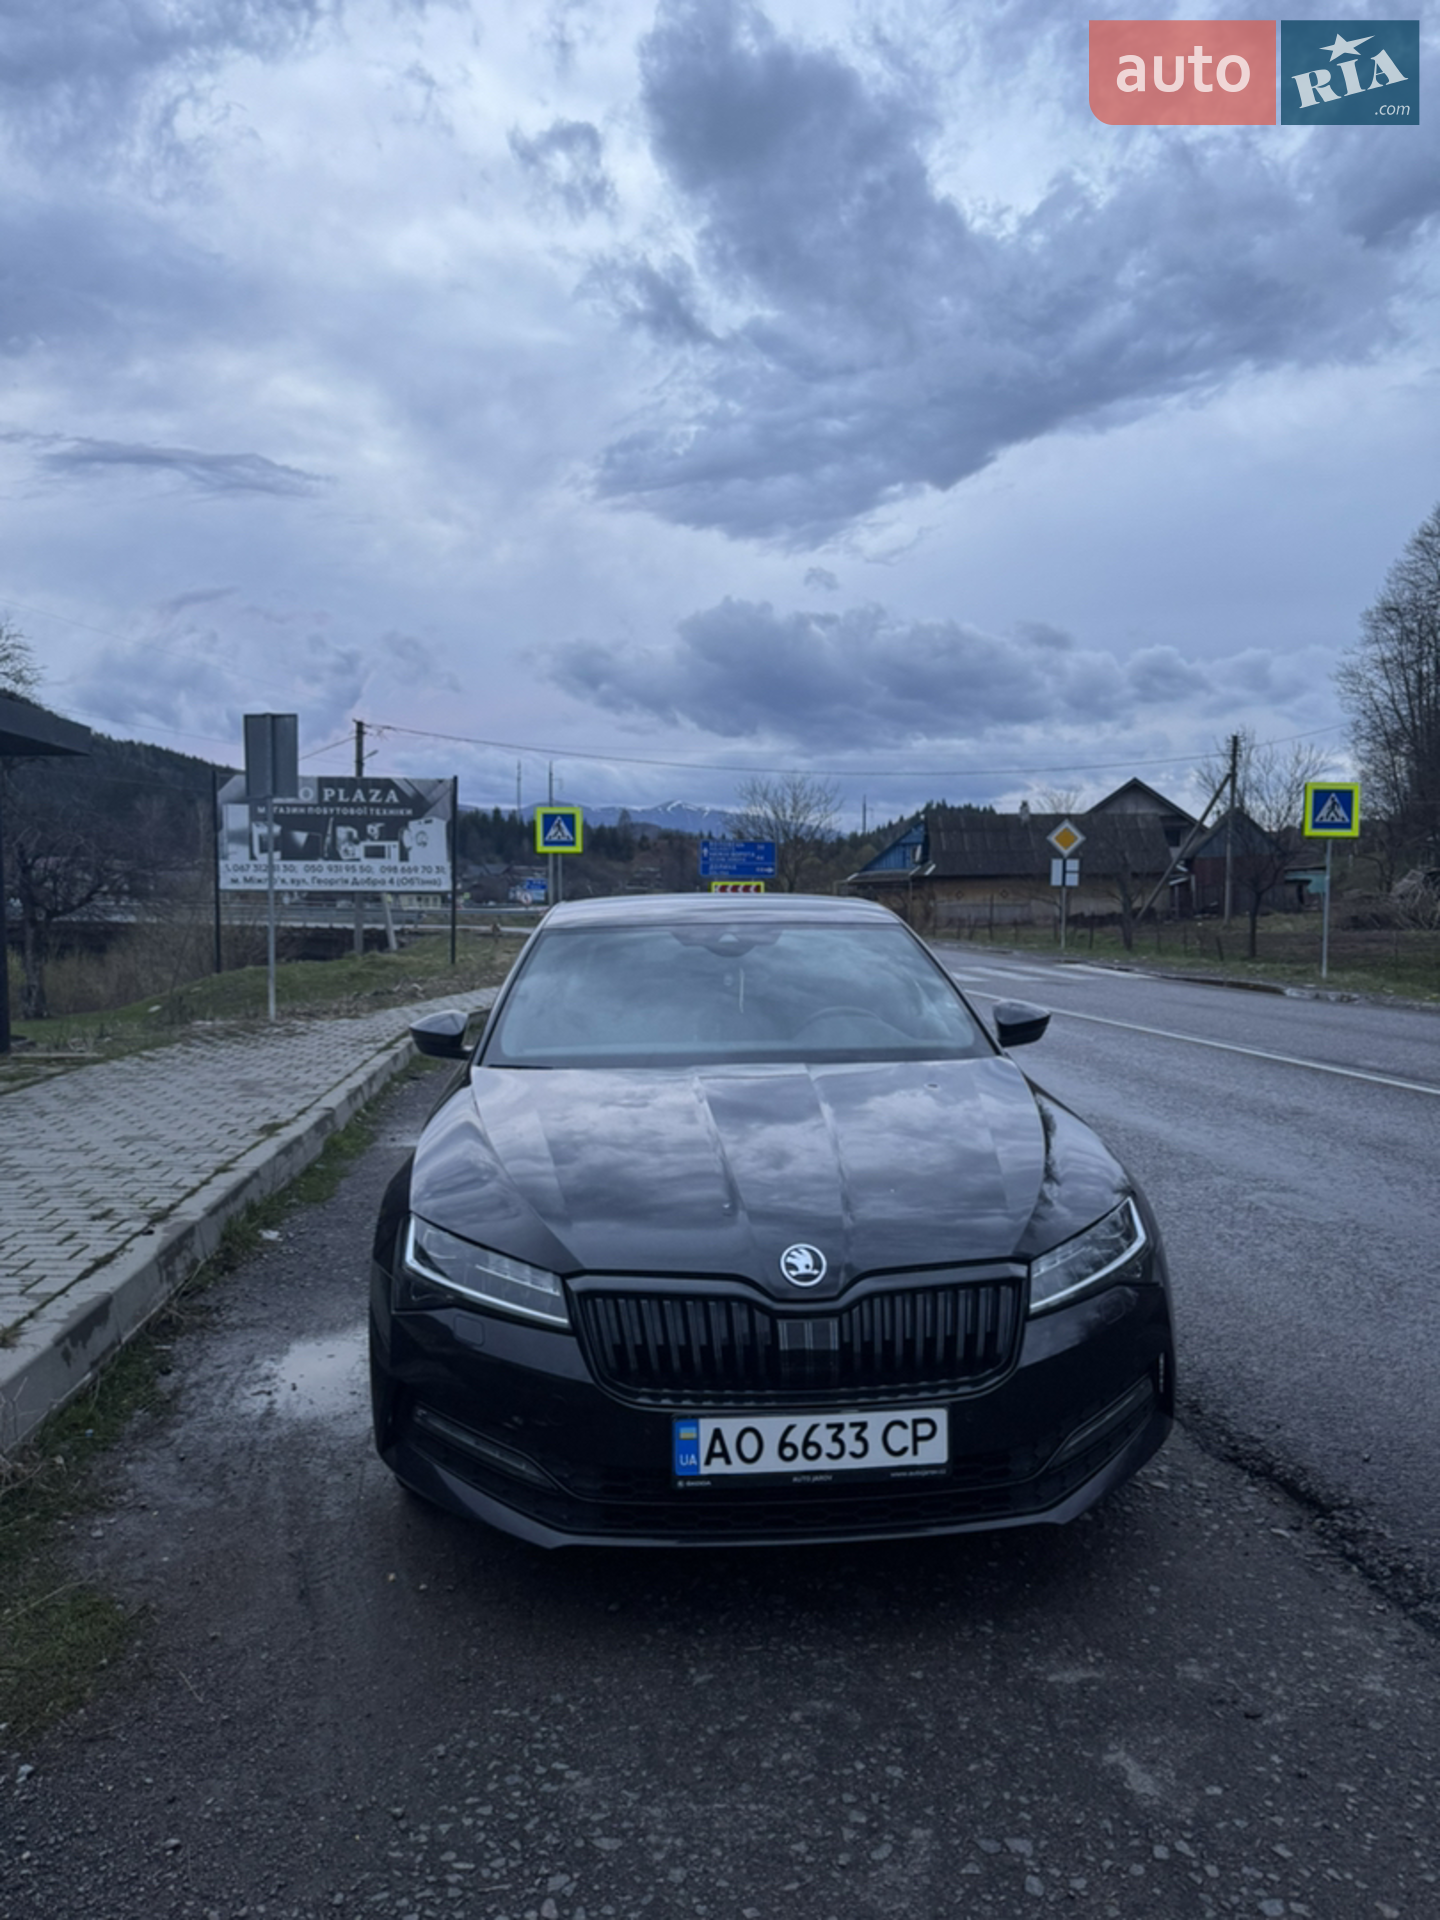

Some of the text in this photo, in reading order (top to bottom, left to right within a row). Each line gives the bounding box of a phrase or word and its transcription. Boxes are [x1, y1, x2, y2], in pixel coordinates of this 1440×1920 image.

[322, 787, 400, 803] PLAZA
[257, 805, 305, 815] МГАЗИН
[304, 863, 324, 873] 050
[703, 1417, 938, 1467] AO 6633 CP
[679, 1454, 698, 1466] UA
